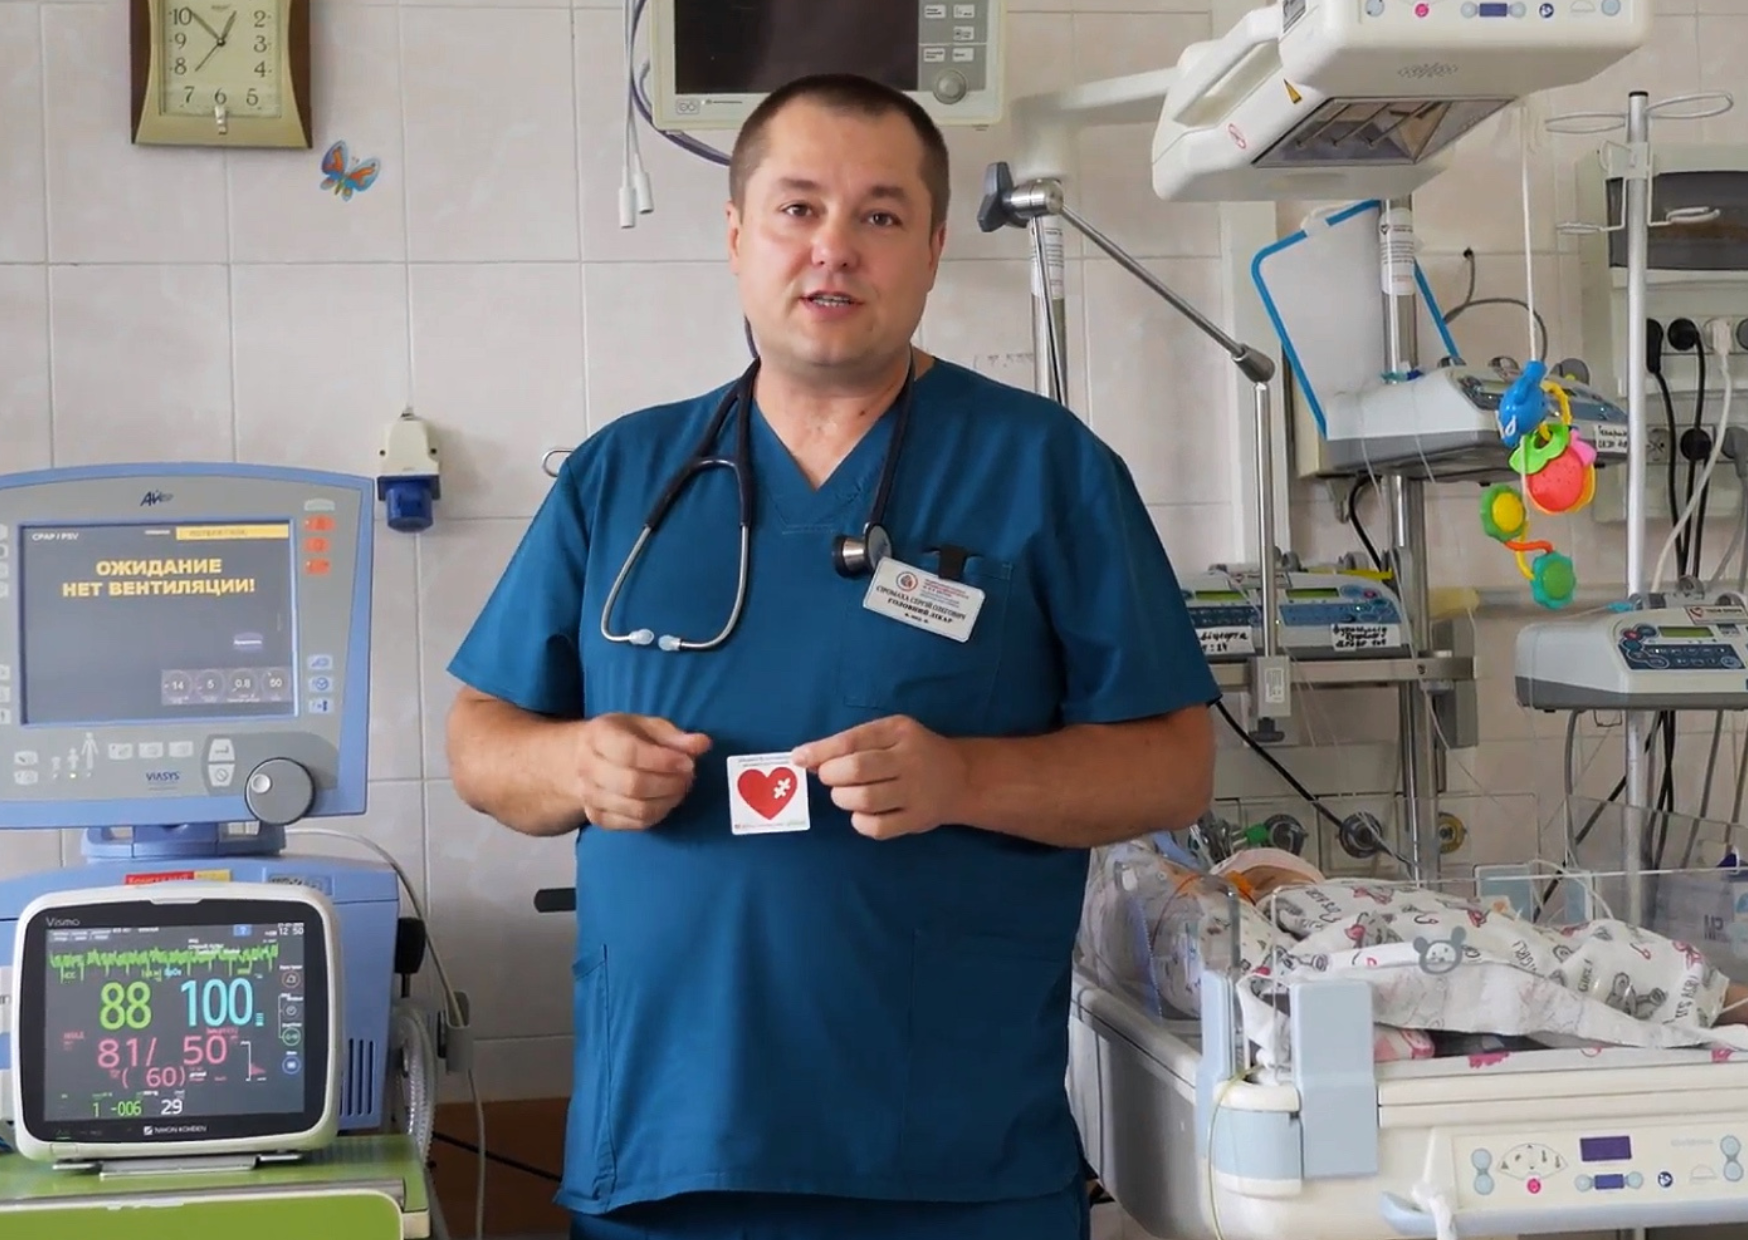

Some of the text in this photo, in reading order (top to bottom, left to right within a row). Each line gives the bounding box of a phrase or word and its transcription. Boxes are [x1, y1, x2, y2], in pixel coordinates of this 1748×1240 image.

[172, 7, 193, 26] 10
[253, 10, 266, 28] 2
[174, 33, 187, 50] 9
[253, 35, 267, 53] 3
[174, 58, 187, 76] 8
[253, 60, 266, 78] 4
[184, 86, 195, 104] 7
[214, 88, 227, 106] 6
[246, 88, 258, 106] 5
[32, 532, 55, 541] CPAP
[61, 532, 80, 541] PSV
[96, 558, 223, 578] ОЖИДАНИЕ
[62, 578, 256, 598] НЕТ ВЕНТИЛЯЦИИ!
[145, 770, 181, 782] VIASYS
[46, 916, 81, 927] Vismo
[100, 977, 254, 1030] 88 100
[182, 1035, 228, 1065] 50
[160, 1098, 184, 1116] 29
